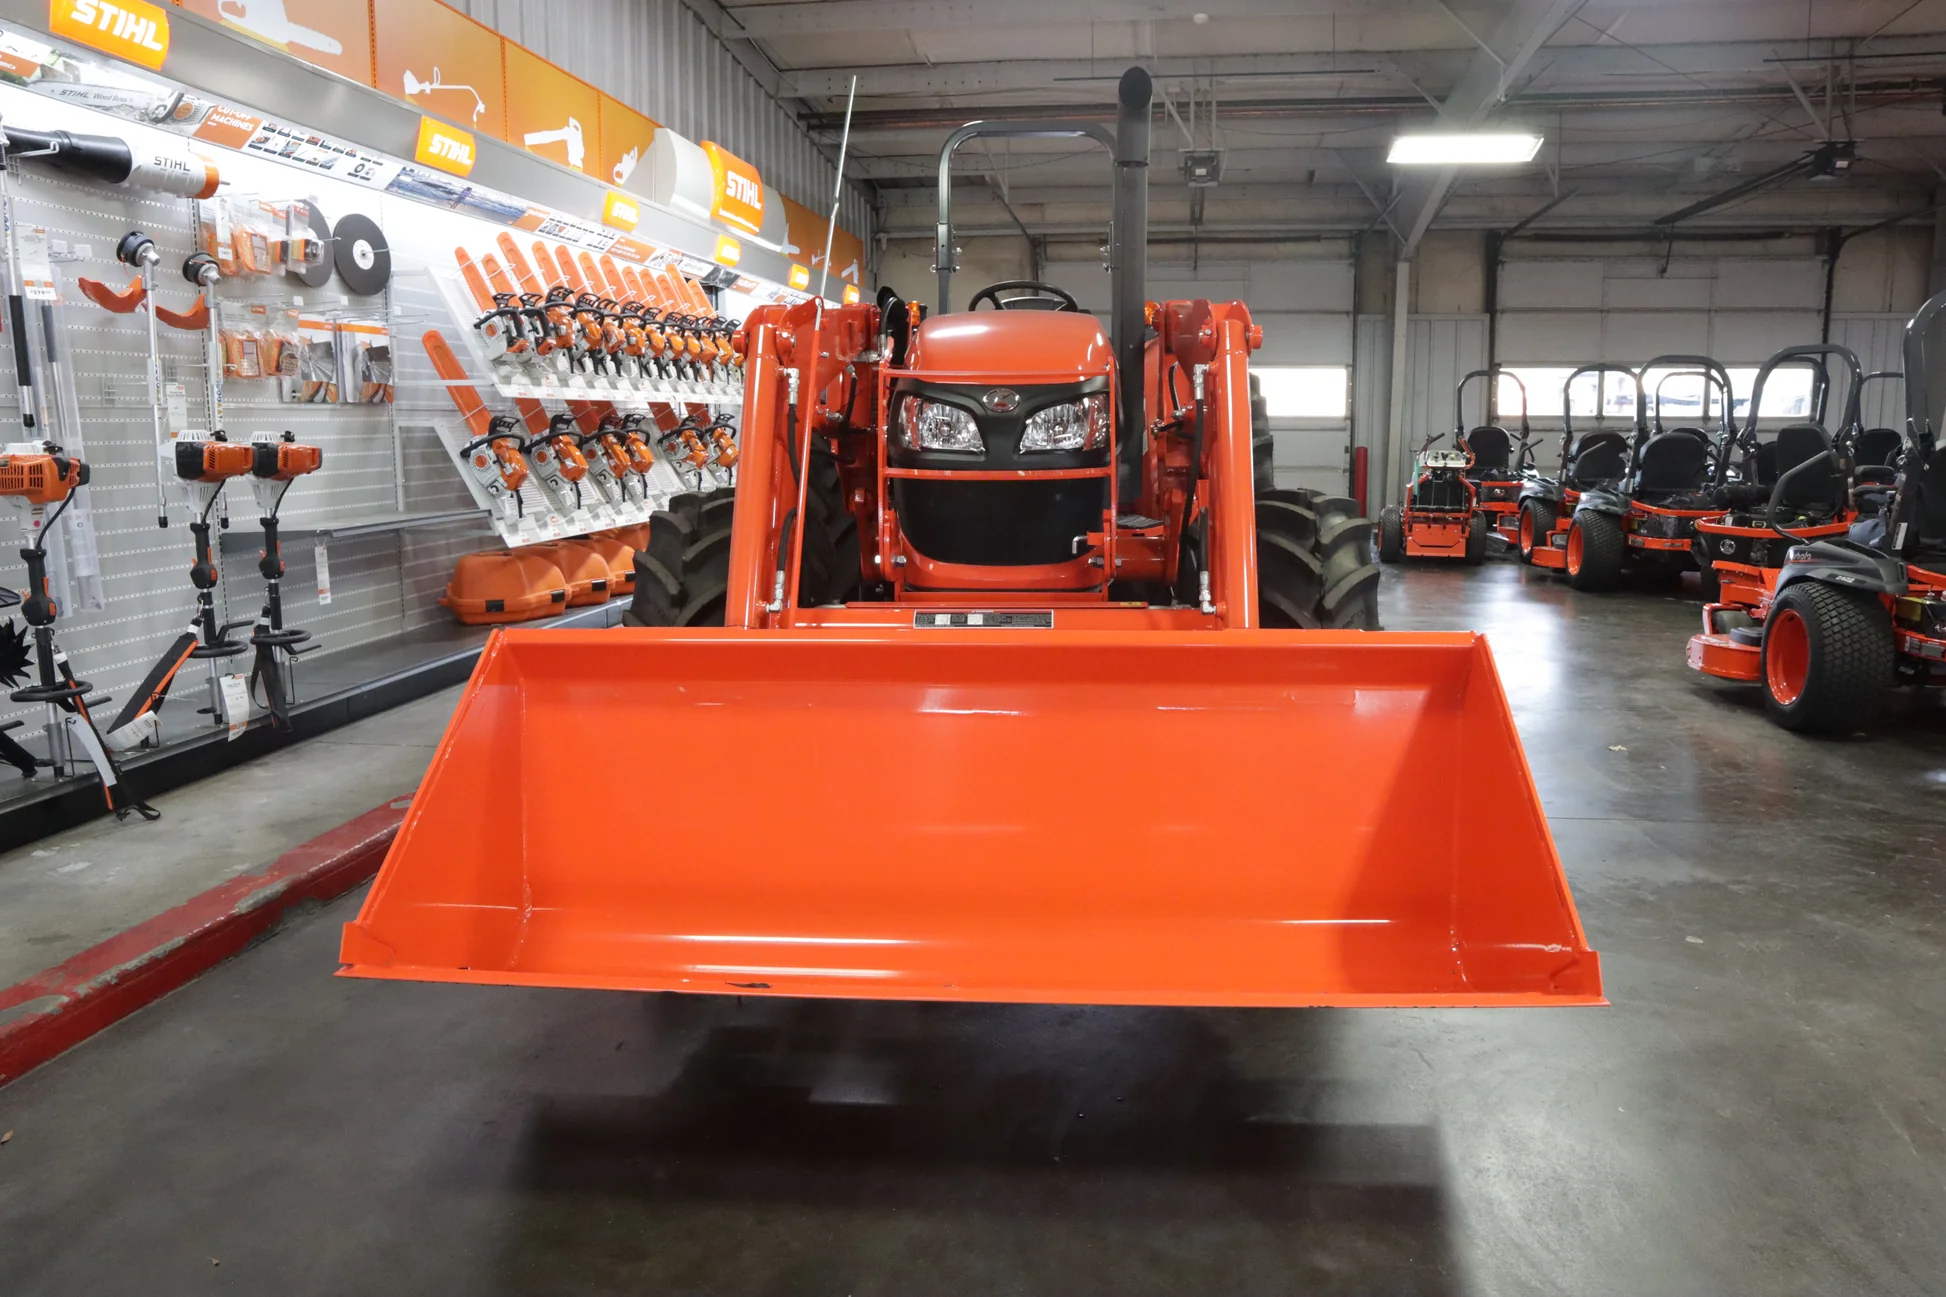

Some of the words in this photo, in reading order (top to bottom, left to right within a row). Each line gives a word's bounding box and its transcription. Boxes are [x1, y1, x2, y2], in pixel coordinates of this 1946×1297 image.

[71, 0, 163, 51] STIHL
[59, 89, 90, 99] STIHL
[93, 93, 112, 101] Wood
[112, 95, 128, 103] Boss
[210, 113, 255, 132] MACHINES
[428, 132, 473, 165] STIHL
[153, 155, 191, 172] STIHL
[726, 170, 762, 210] STIHL
